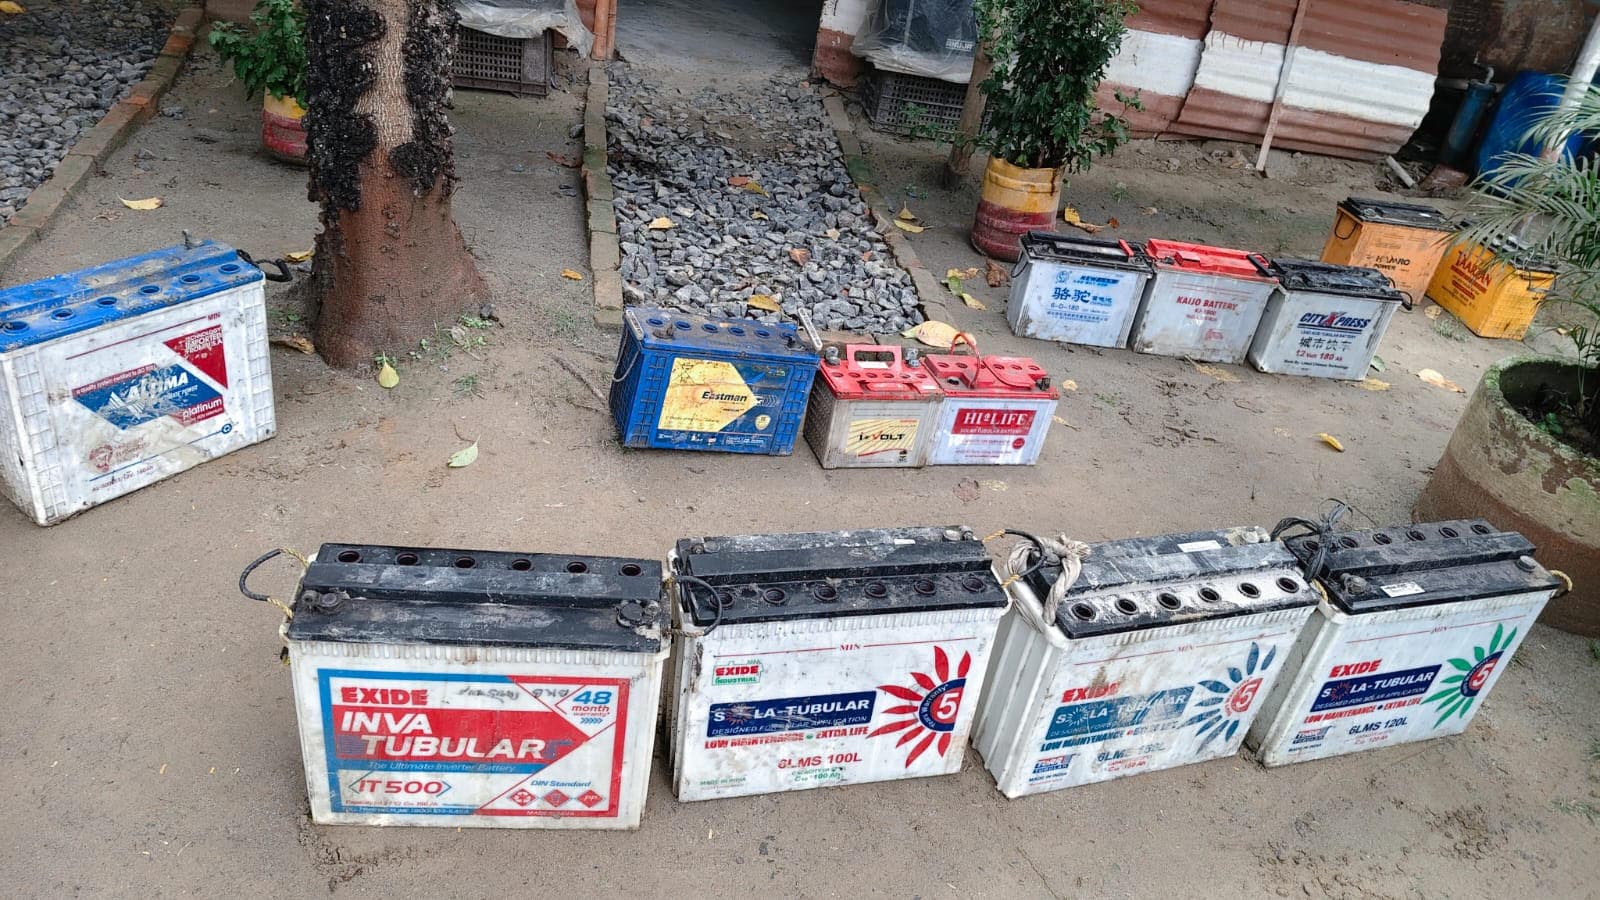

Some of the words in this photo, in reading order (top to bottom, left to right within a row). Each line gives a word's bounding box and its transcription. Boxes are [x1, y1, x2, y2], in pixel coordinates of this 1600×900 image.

[1052, 287, 1091, 303] 骆驼
[1176, 296, 1202, 305] KAIJO
[1203, 299, 1238, 311] BATTERY
[1296, 349, 1306, 358] 12
[1320, 352, 1335, 360] 180
[702, 388, 748, 402] Eastman
[183, 398, 222, 422] platinum
[716, 665, 759, 677] EXIDE
[1329, 659, 1382, 678] EXIDE
[1472, 662, 1495, 687] 5
[341, 687, 428, 706] EXIDE
[573, 690, 612, 705] 48
[1061, 682, 1119, 703] EXIDE
[1236, 683, 1258, 709] 5
[937, 692, 960, 719] 5
[1304, 713, 1322, 724] LOW
[1323, 705, 1376, 720] MAINTENANCE
[341, 711, 433, 735] INVA
[712, 726, 760, 735] DESIGNED
[812, 716, 867, 726] APPLICATION
[1348, 722, 1381, 735] 6LMS
[1384, 717, 1407, 729] 120L
[361, 735, 546, 759] TUBULAR
[705, 740, 728, 749] LOW
[849, 726, 869, 737] LIFE
[1040, 740, 1063, 752] LOW
[390, 762, 433, 770] Ultimate
[436, 763, 475, 771] Inverter
[479, 764, 516, 772] Battery
[828, 752, 863, 764] 100L
[359, 780, 382, 793] IT
[385, 781, 443, 794] 500
